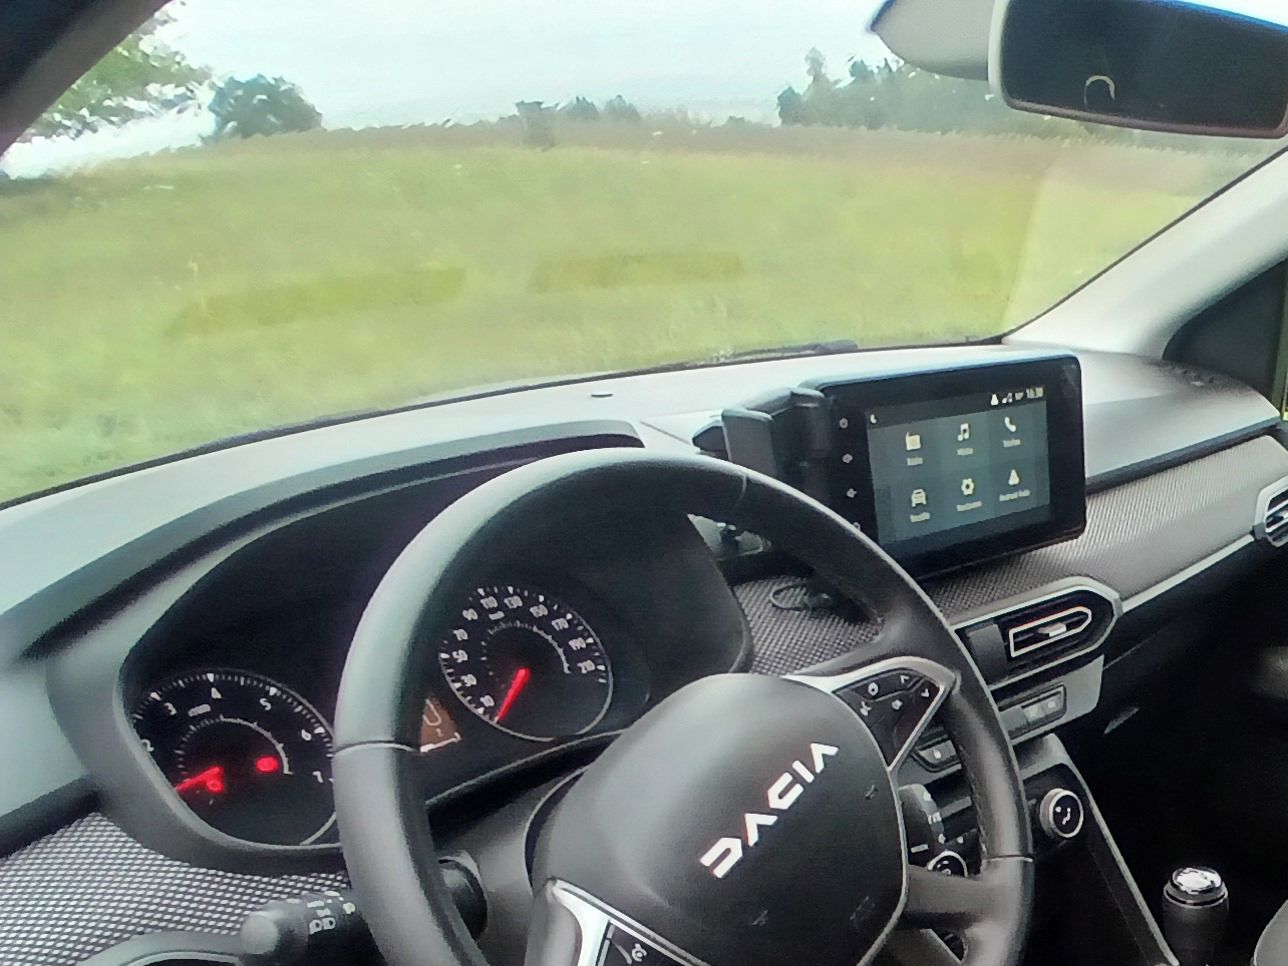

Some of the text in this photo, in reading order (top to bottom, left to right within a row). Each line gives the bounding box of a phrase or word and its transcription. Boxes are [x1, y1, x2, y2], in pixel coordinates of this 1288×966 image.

[211, 687, 222, 699] 4
[164, 702, 177, 716] 3
[259, 697, 272, 711] 5
[301, 729, 312, 742] 6
[141, 739, 154, 752] 2
[700, 742, 839, 878] DACIA
